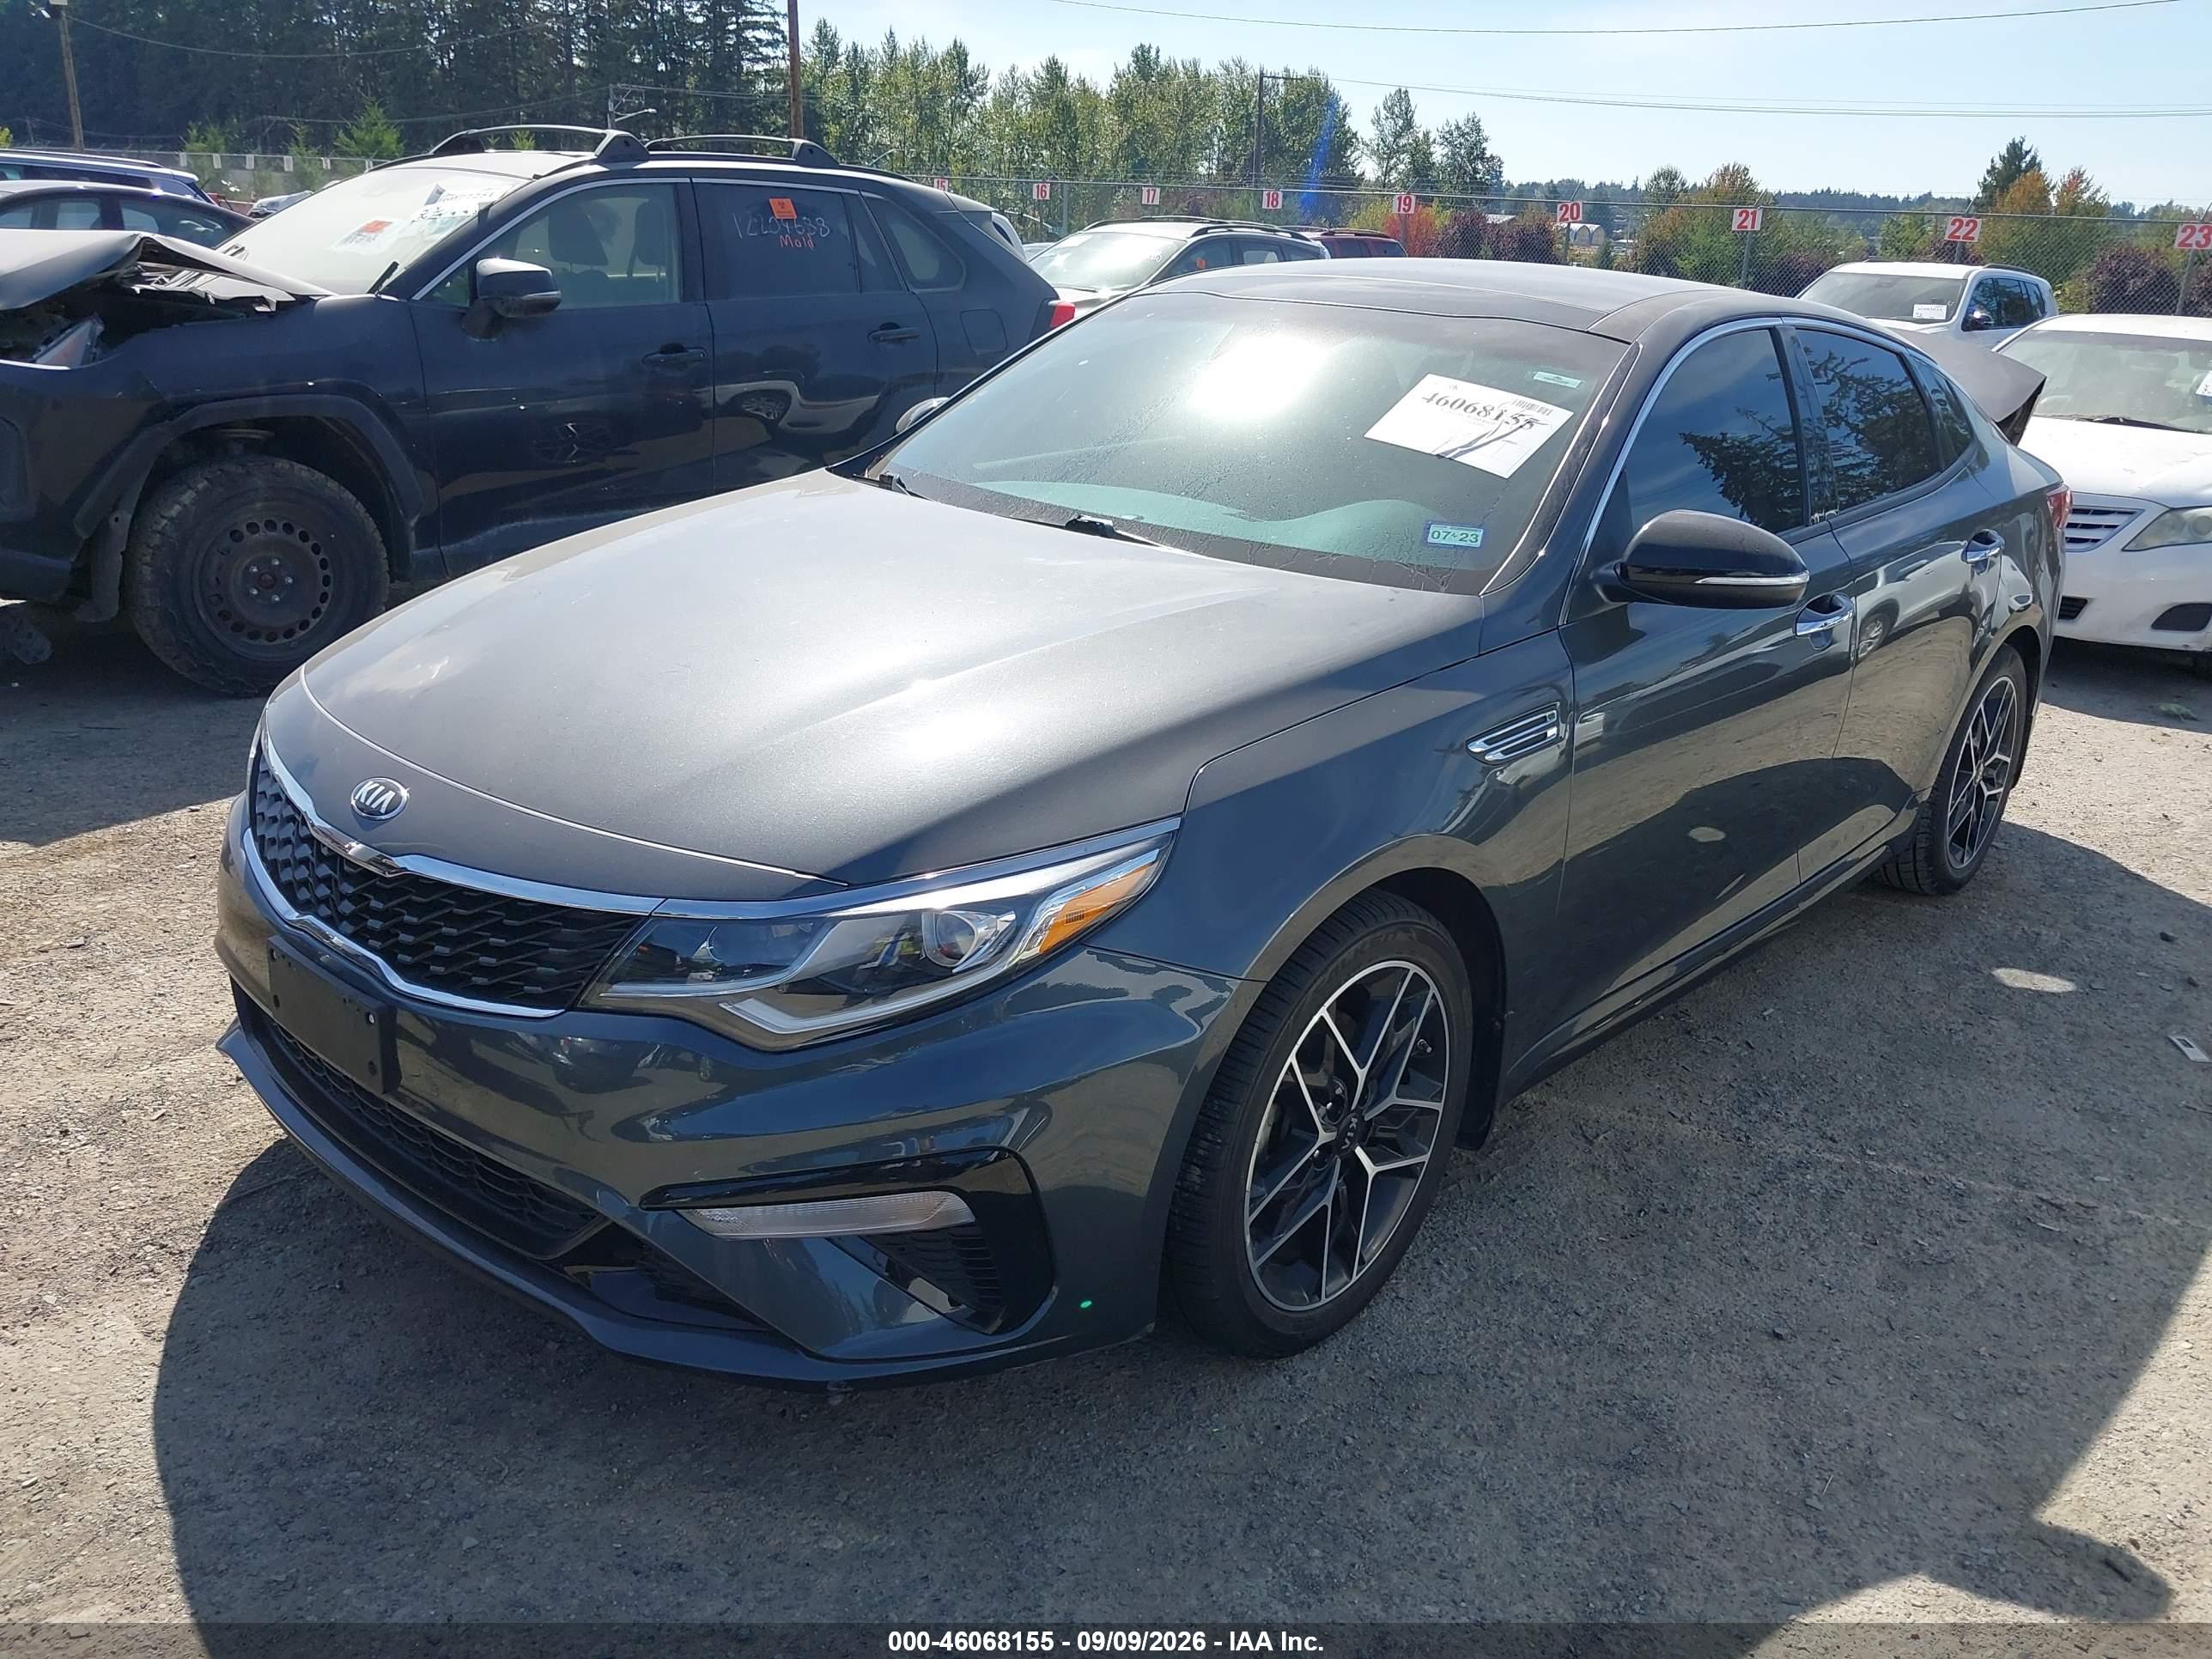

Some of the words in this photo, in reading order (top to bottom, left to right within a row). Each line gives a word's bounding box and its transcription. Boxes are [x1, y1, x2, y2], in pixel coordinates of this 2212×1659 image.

[1036, 185, 1048, 198] 16
[1146, 188, 1157, 204] 17
[1267, 191, 1279, 208] 18
[1396, 195, 1413, 213] 19
[1559, 202, 1580, 222] 20
[1736, 210, 1758, 229] 21
[1948, 218, 1978, 240] 22
[2178, 224, 2212, 248] 23
[779, 233, 815, 249] Mold
[354, 781, 396, 815] KIA
